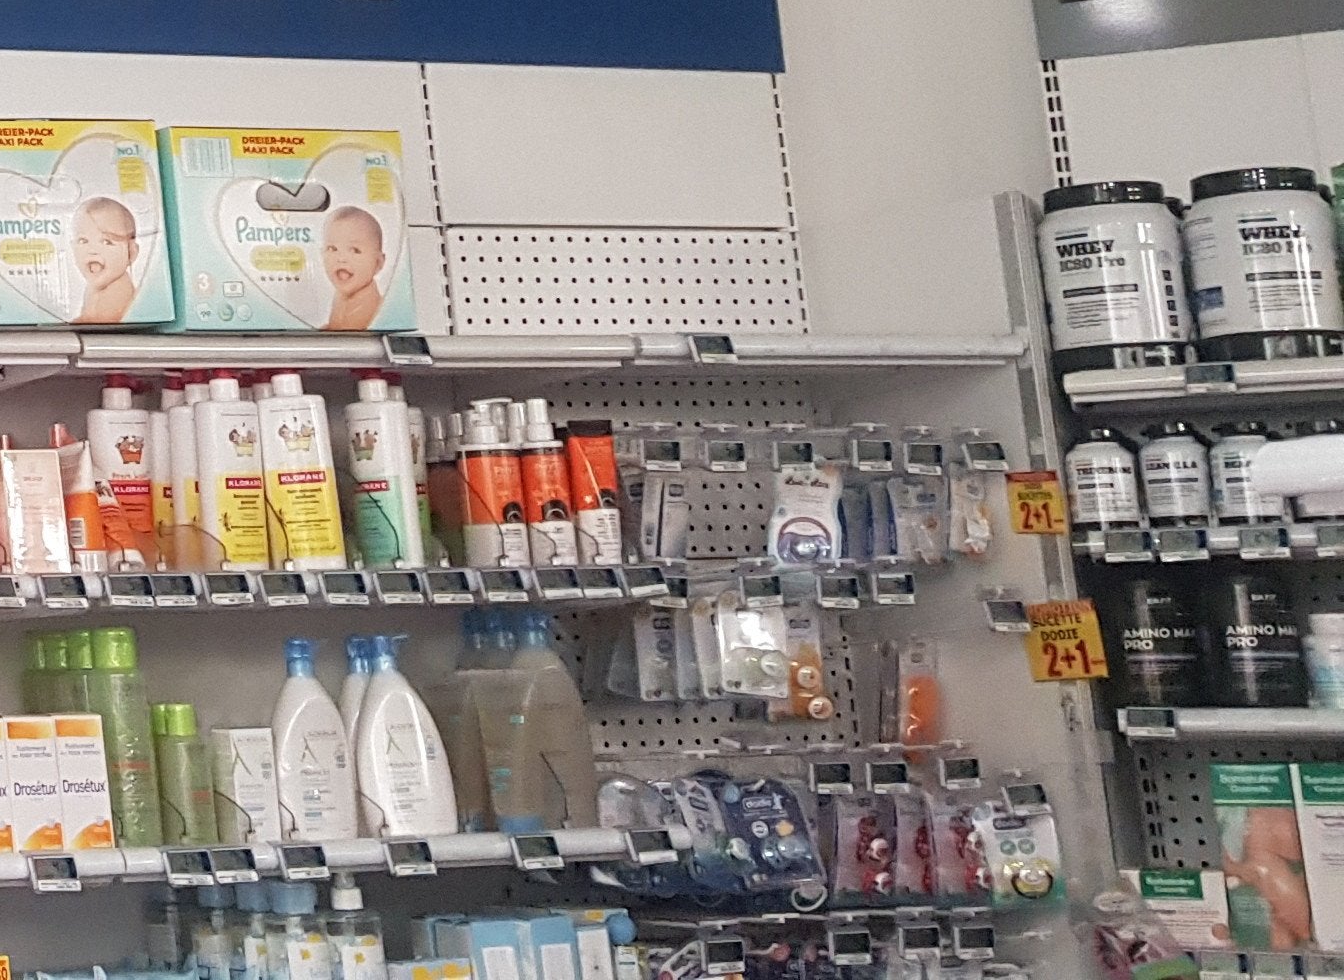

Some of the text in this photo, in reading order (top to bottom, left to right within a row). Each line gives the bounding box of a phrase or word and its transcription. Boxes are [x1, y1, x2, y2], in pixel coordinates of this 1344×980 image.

[17, 137, 44, 146] PACK
[270, 146, 295, 154] PACK
[235, 216, 312, 245] Pampers
[1056, 240, 1114, 258] WHEY
[281, 473, 324, 483] KLORANE
[1040, 628, 1079, 641] DODIE
[1123, 628, 1170, 638] AMINO
[1226, 625, 1275, 635] AMINO
[1124, 639, 1154, 650] PRO
[1226, 636, 1258, 647] PRO
[1042, 639, 1091, 677] 2+1
[14, 781, 58, 797] Drosétux
[62, 778, 106, 794] Drosétux
